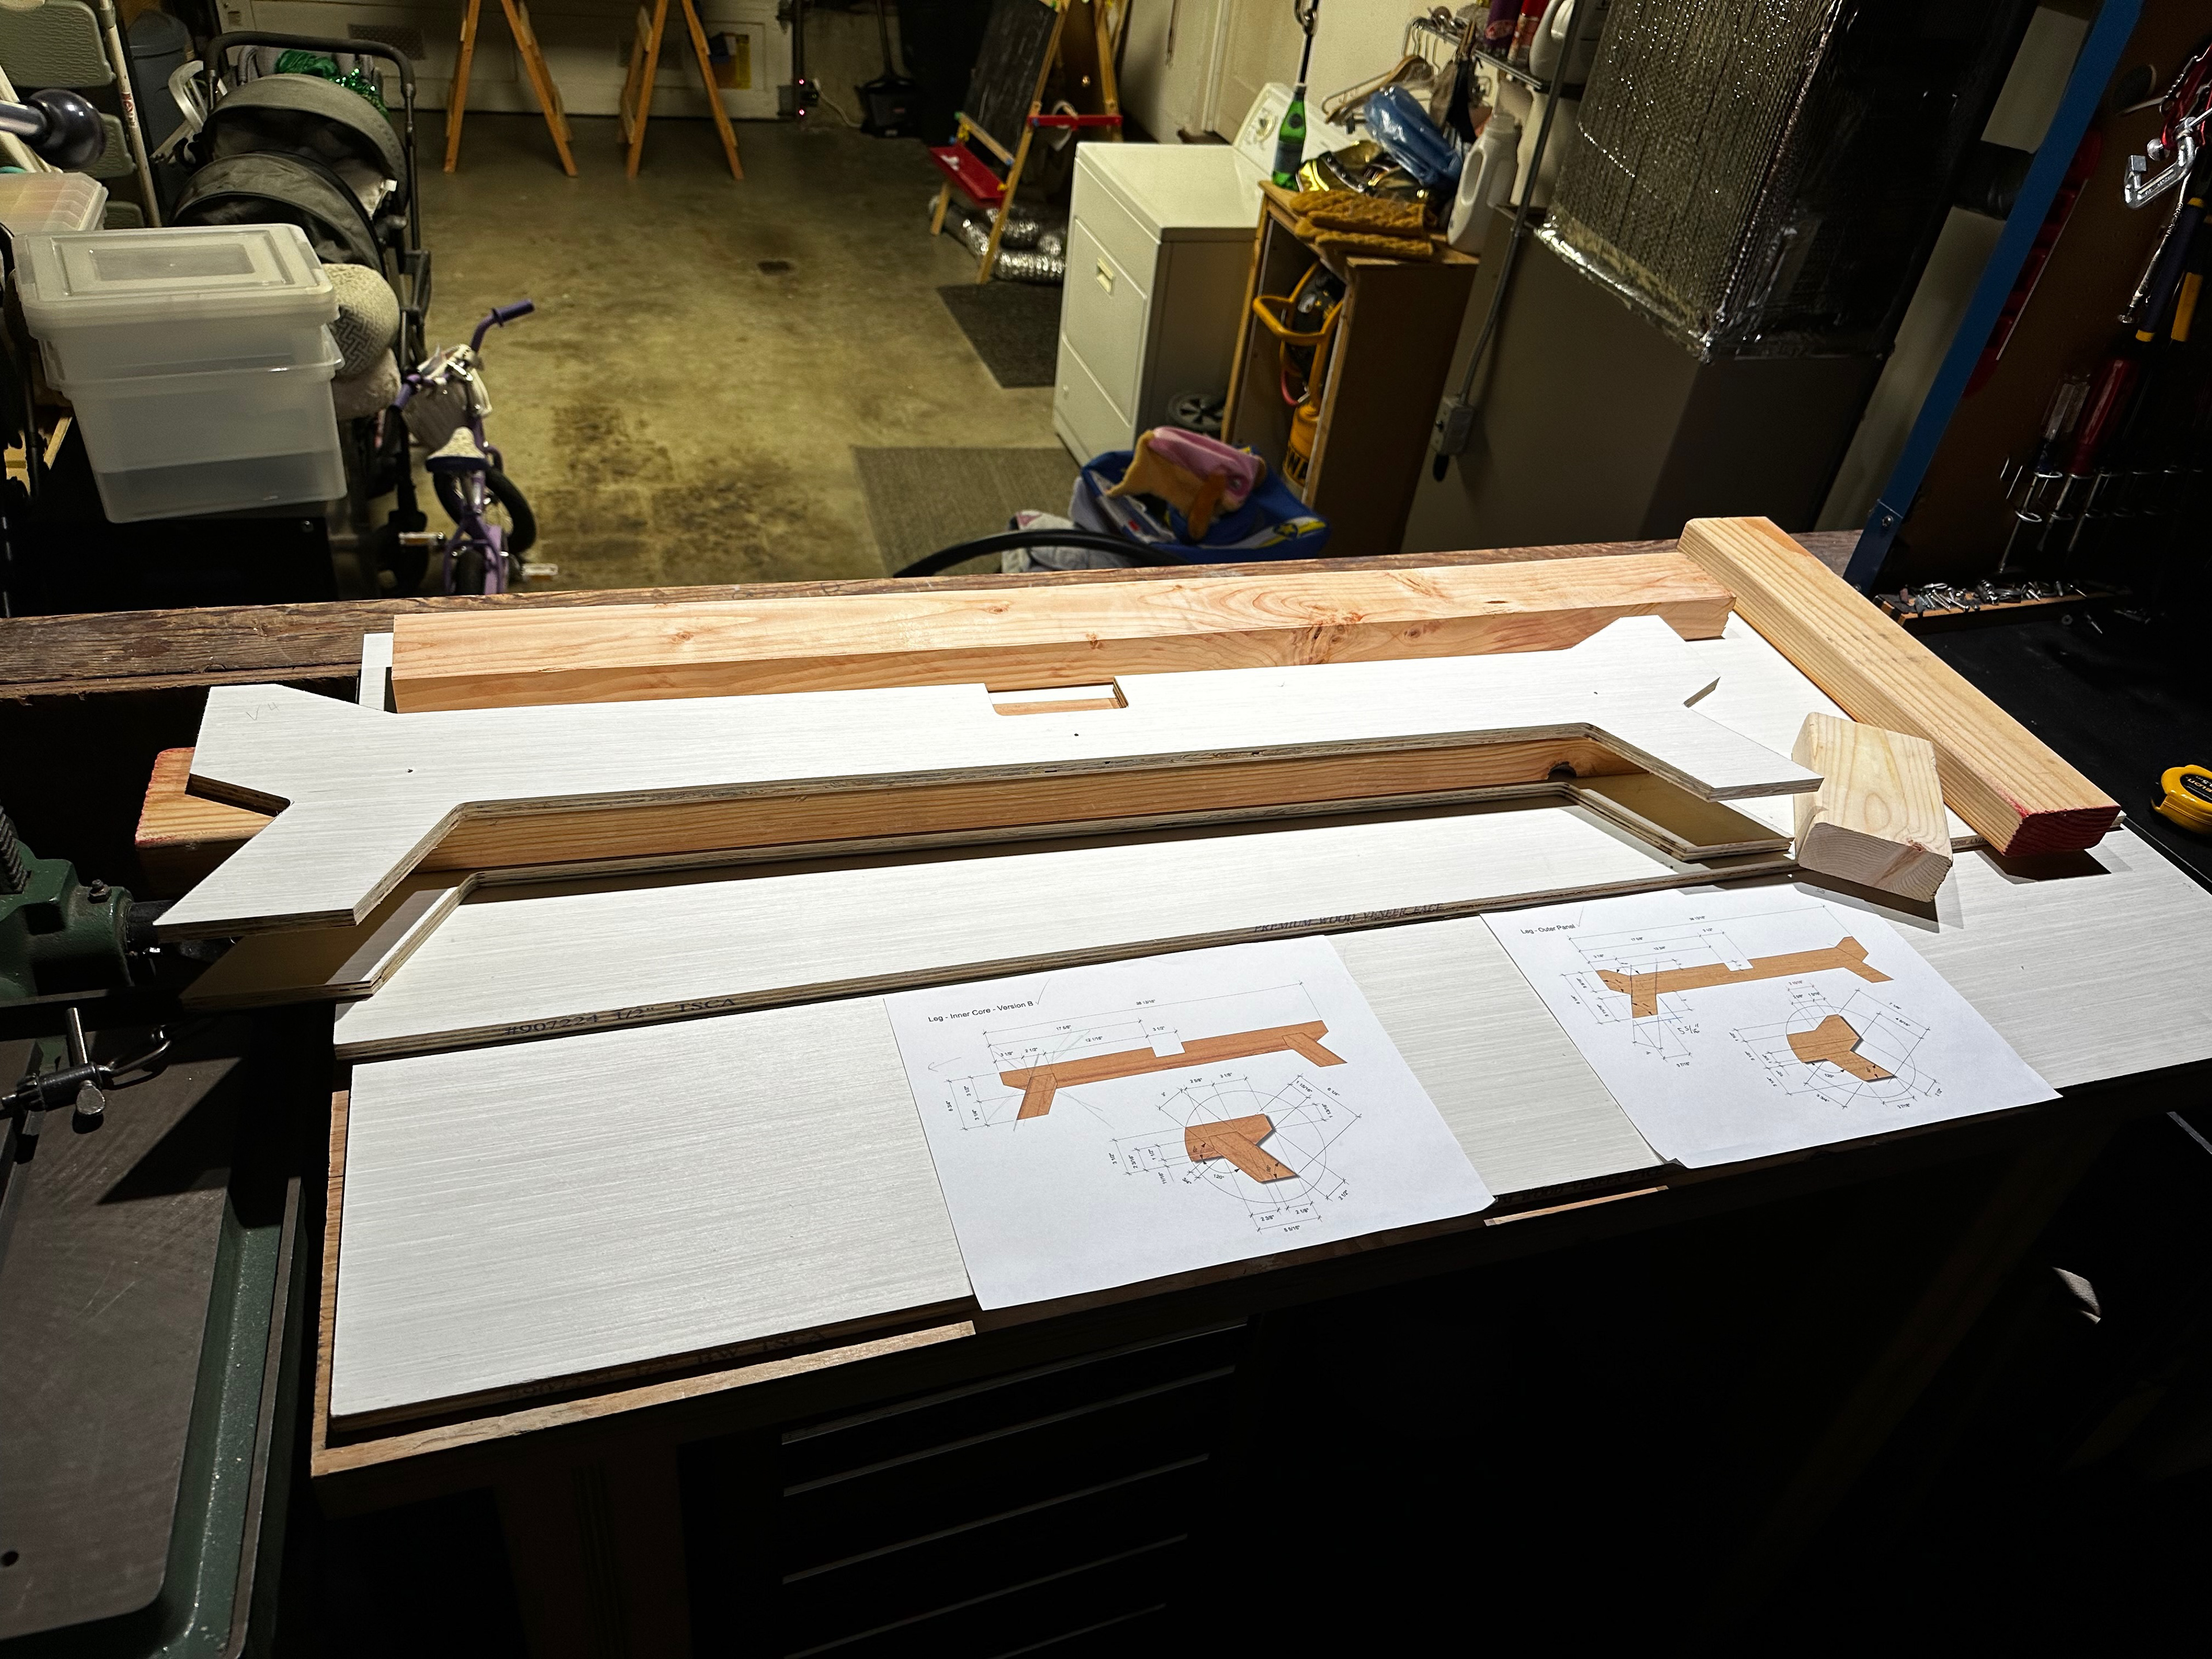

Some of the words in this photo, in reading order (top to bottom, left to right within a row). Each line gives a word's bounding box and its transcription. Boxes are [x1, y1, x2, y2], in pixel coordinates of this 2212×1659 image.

[505, 1014, 598, 1035] #907224
[674, 998, 736, 1012] TSCA
[997, 1003, 1027, 1011] Version
